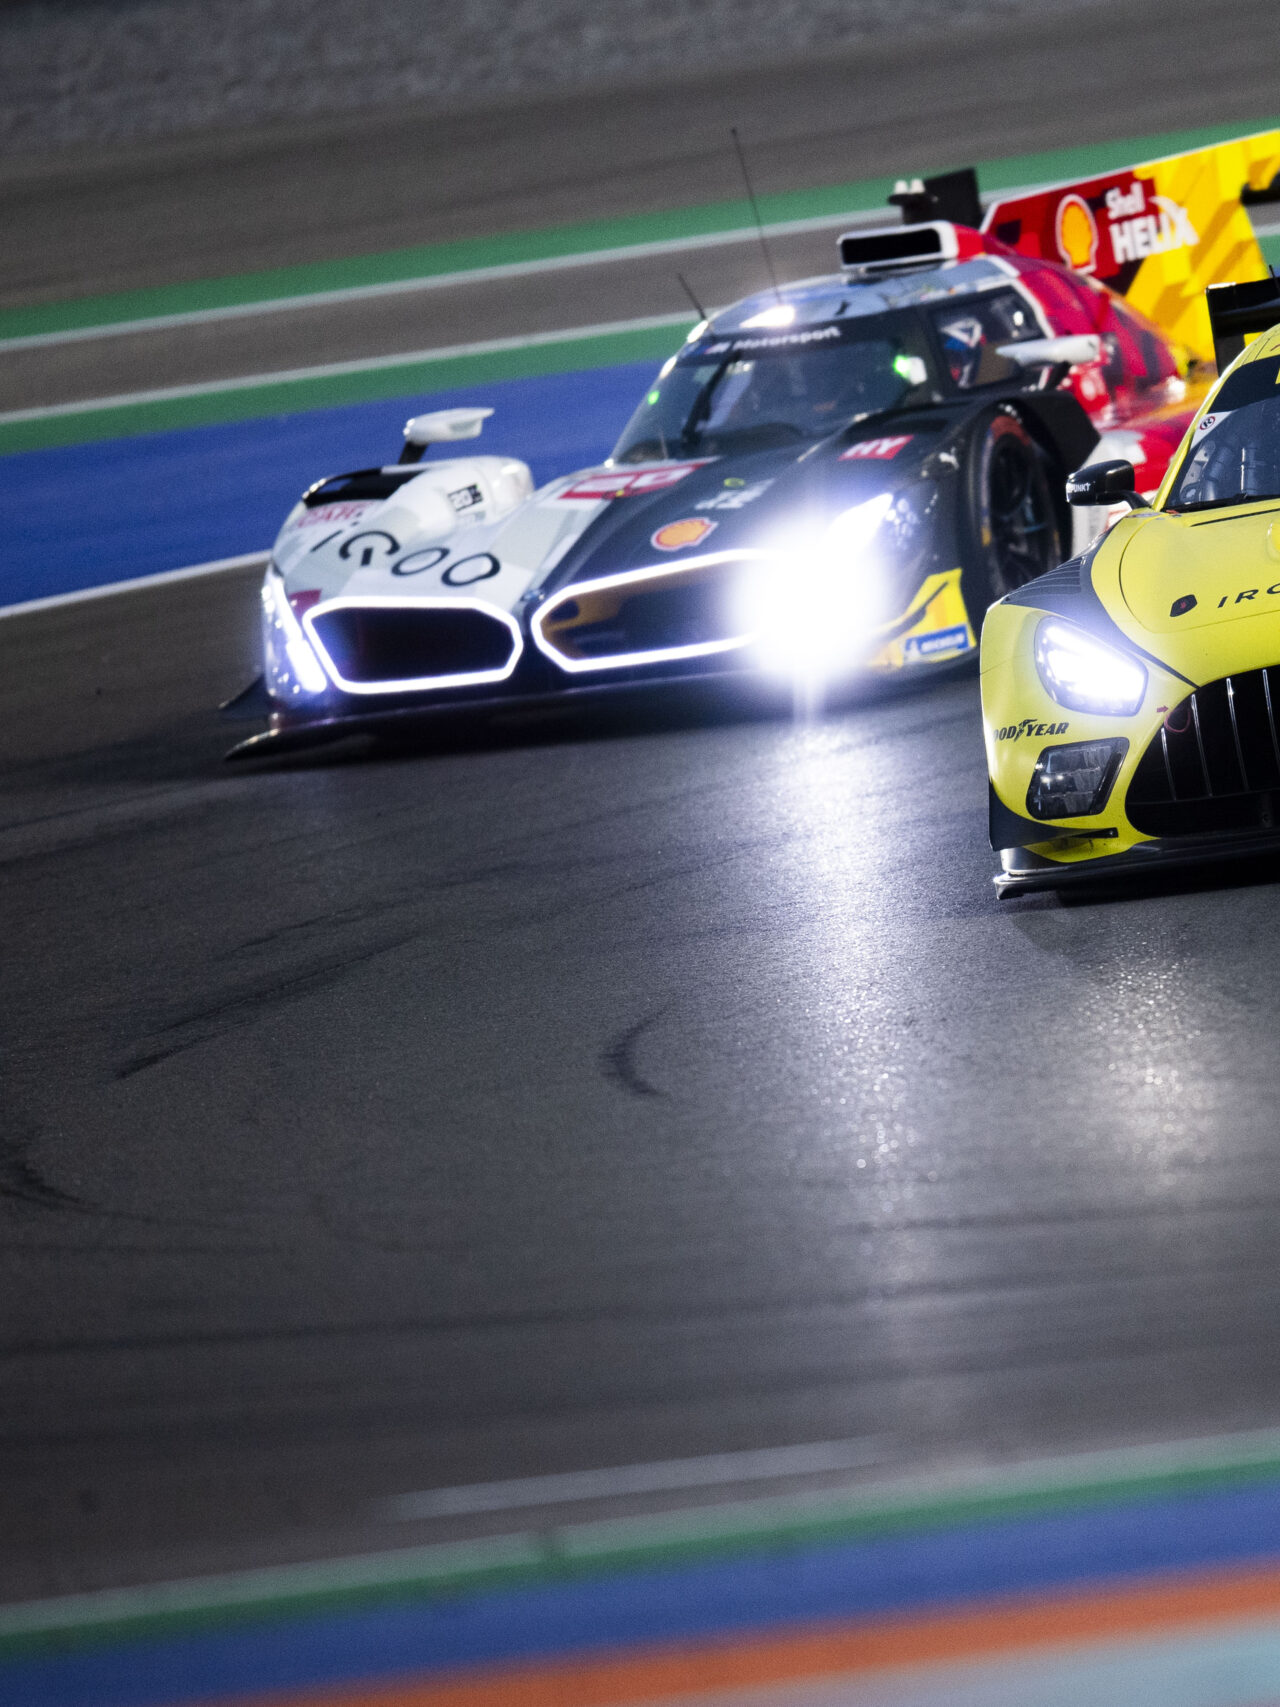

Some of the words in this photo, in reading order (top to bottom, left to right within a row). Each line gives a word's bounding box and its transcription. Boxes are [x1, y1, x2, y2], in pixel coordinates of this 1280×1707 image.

[1106, 181, 1145, 219] Shell
[1109, 196, 1199, 264] HELIX
[732, 326, 841, 351] Motorsport
[845, 436, 899, 455] HY
